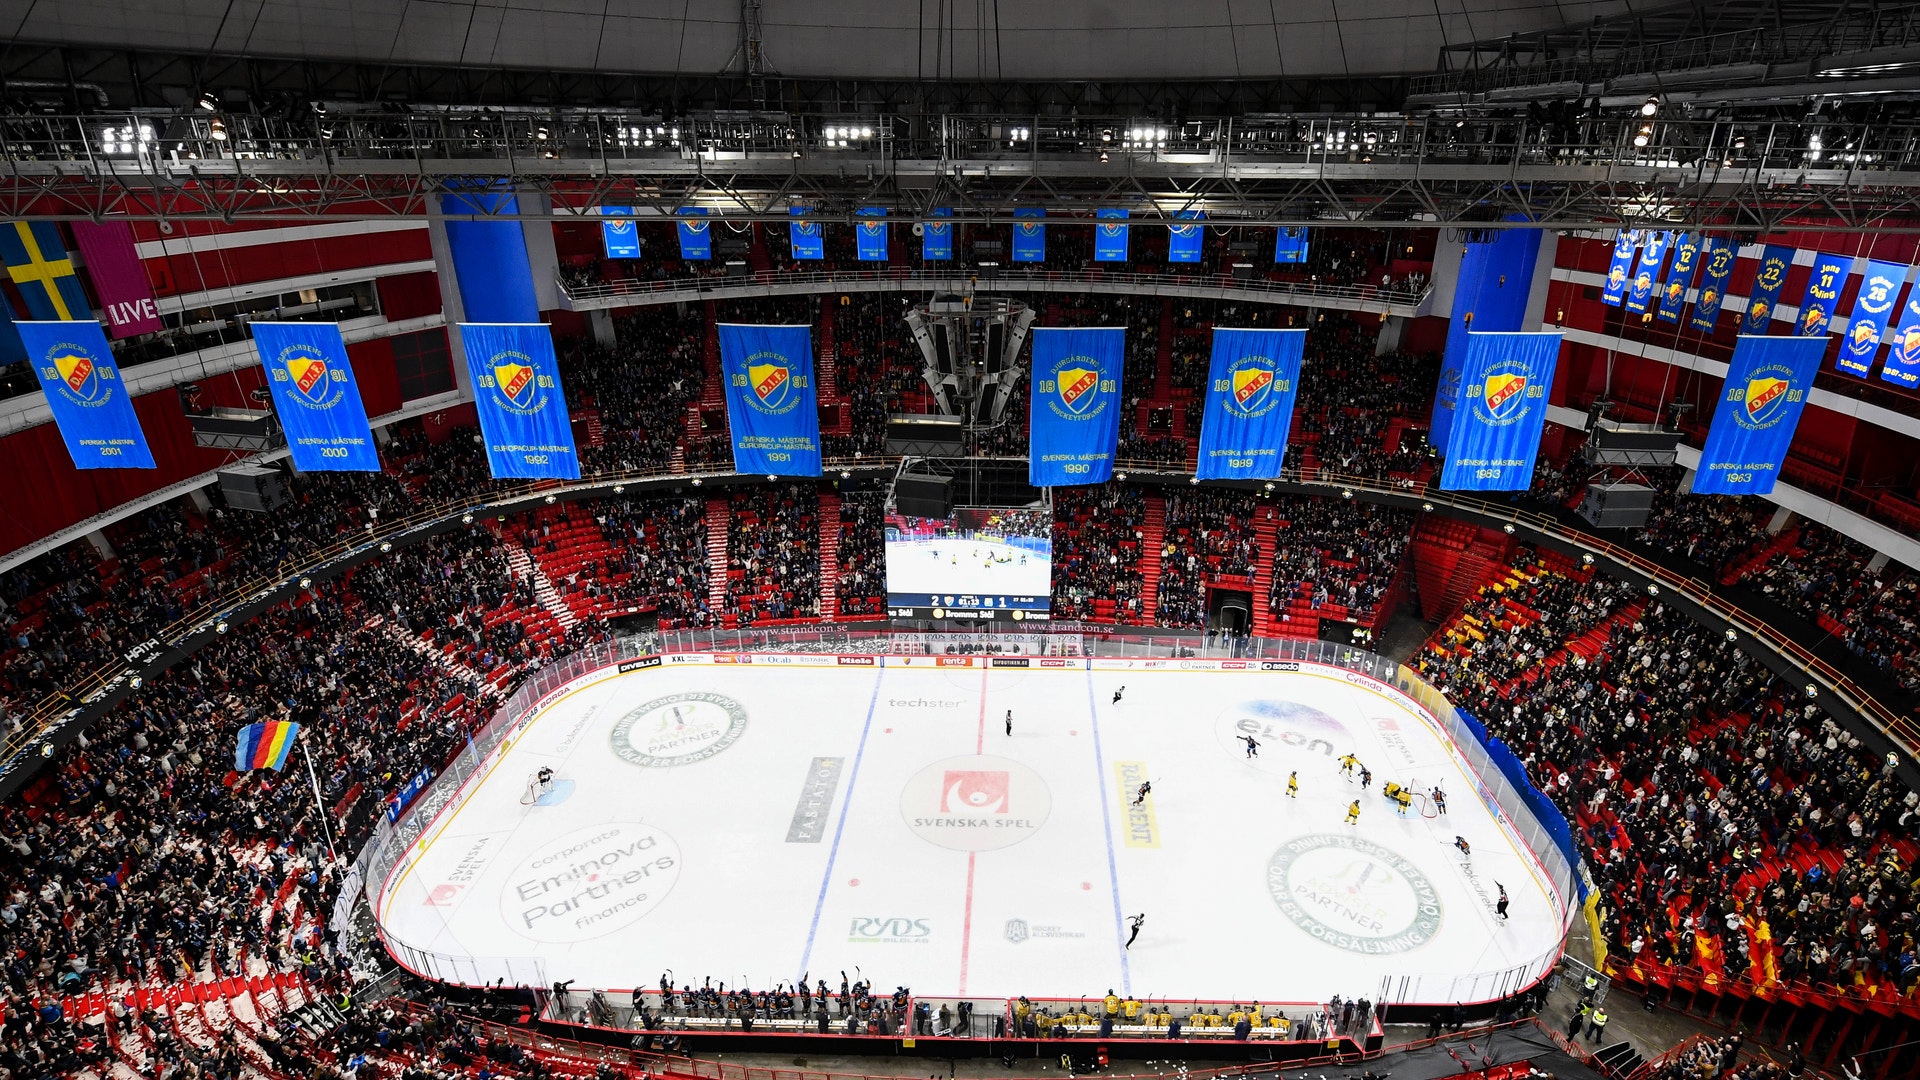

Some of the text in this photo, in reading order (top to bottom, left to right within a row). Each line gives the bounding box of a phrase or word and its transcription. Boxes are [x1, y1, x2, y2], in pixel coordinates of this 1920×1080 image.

[1681, 251, 1692, 263] 12
[1713, 256, 1728, 268] 27
[1764, 267, 1780, 280] 22
[1820, 264, 1840, 274] Jens
[1821, 274, 1834, 288] 11
[108, 298, 157, 326] LIVE
[41, 367, 115, 380] 18 91
[70, 361, 91, 387] D.I.F.
[272, 368, 348, 383] 18 91
[300, 364, 323, 390] D.I.F.
[479, 374, 554, 388] 18 91
[507, 370, 531, 395] D.I.F.
[732, 374, 808, 388] 18 91
[759, 371, 785, 395] D.I.F.
[1039, 380, 1116, 392] 18 91
[1067, 375, 1094, 400] D.I.F.
[1214, 379, 1290, 392] 18 91
[1240, 374, 1269, 400] D.I.F.
[1466, 384, 1544, 398] 18 91
[1492, 381, 1523, 405] D.I.F.
[1727, 388, 1745, 402] 18
[1752, 384, 1784, 410] D.I.F.
[331, 436, 365, 445] MÄSTARE
[778, 436, 811, 444] MÄSTARE
[100, 447, 122, 455] 2001
[320, 447, 348, 458] 2000
[767, 453, 791, 462] 1991
[1042, 452, 1110, 462] SVENSKA MÄSTARE
[1209, 448, 1276, 457] SVENSKA MÄSTARE
[524, 455, 549, 465] 1992
[1228, 459, 1254, 468] 1989
[1491, 458, 1524, 466] MÄSTARE
[1063, 464, 1090, 474] 1990
[1475, 469, 1501, 479] 1983
[1726, 473, 1752, 483] 1963
[931, 596, 939, 606] 2
[999, 597, 1006, 608] 1
[945, 610, 995, 619] Bromma Stål
[750, 624, 848, 638] www.strandcon.se
[1018, 622, 1114, 633] www.strandcon.se
[124, 638, 159, 662] HATA
[621, 658, 660, 672] DIVELLO
[768, 656, 792, 664] Ocab
[942, 657, 966, 665] renta
[1272, 662, 1298, 670] asedo
[1346, 673, 1382, 692] Cylinda
[540, 687, 570, 710] BORGA
[889, 698, 962, 708] techster
[648, 729, 720, 753] PARTNER
[915, 818, 1034, 828] SVENSKA SPEL
[531, 829, 622, 869] corporate
[448, 837, 489, 881] SVENSKA
[460, 858, 486, 882] SPEL
[516, 836, 657, 902] Eminova
[522, 856, 675, 930] Partners
[574, 893, 648, 930] finance
[1295, 885, 1384, 934] PARTNER
[849, 917, 930, 938] RYDS
